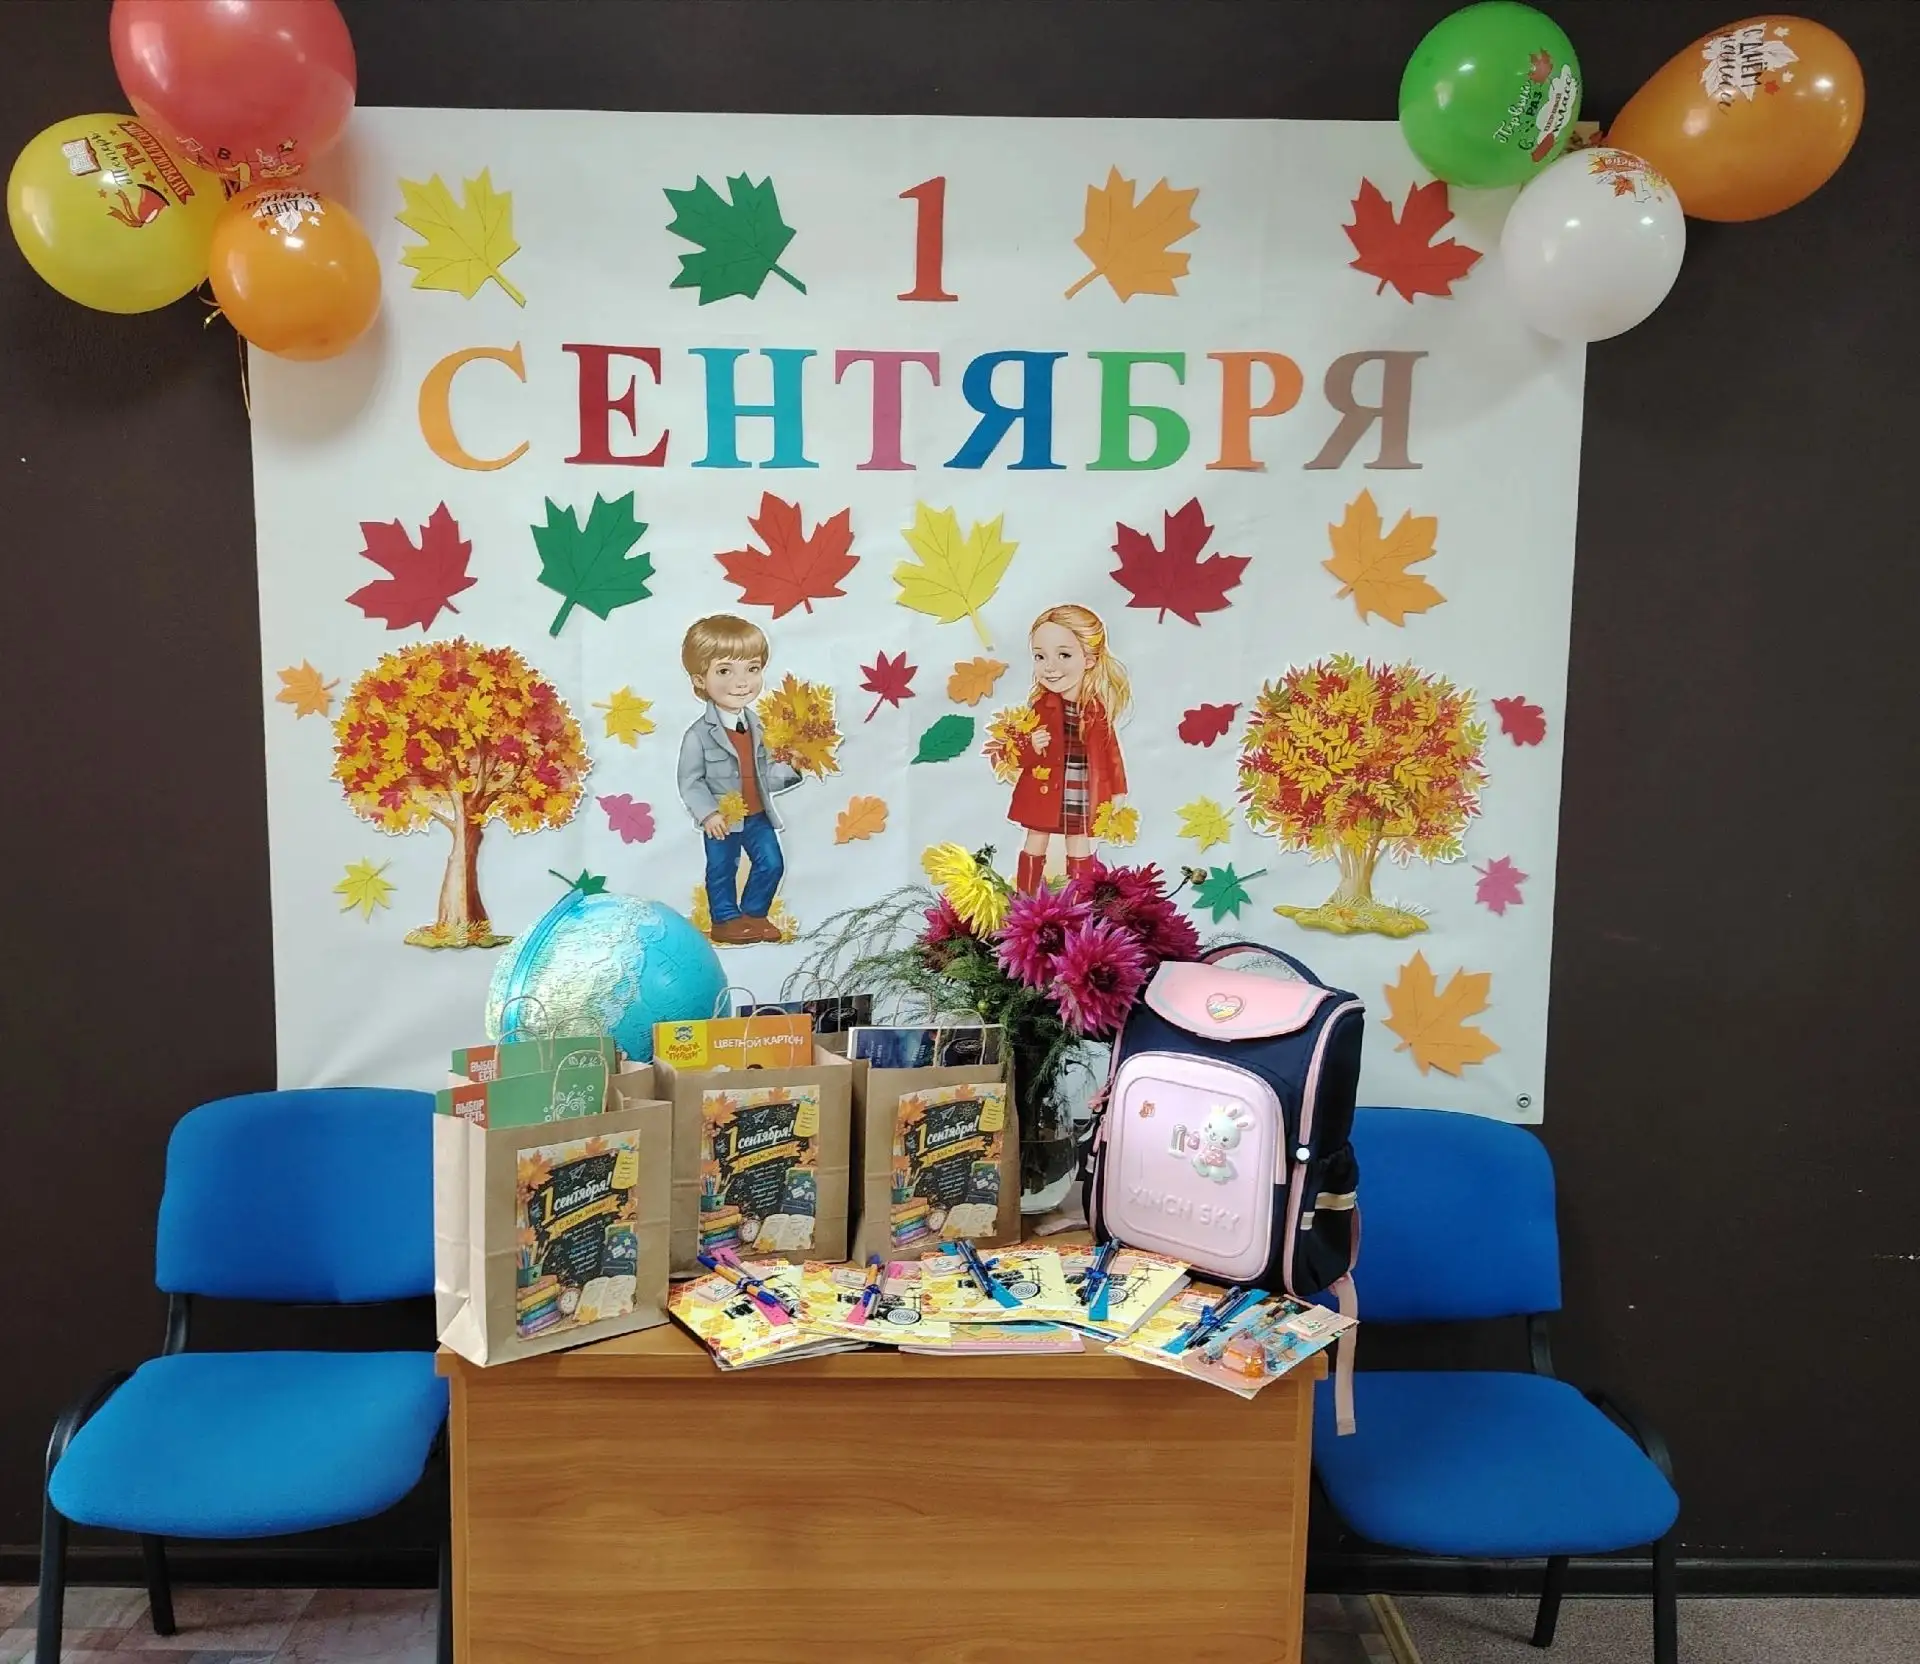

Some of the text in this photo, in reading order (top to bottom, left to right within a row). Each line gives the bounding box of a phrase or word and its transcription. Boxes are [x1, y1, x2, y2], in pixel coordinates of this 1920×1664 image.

[1493, 81, 1531, 143] Первый
[115, 142, 146, 170] ТЫ
[897, 176, 958, 301] 1
[418, 341, 1429, 471] СЕНТЯБРЯ
[714, 1034, 804, 1050] ЦВЕТНОЙ КАРТОН
[455, 1099, 484, 1115] ВЫБОР
[724, 1120, 795, 1161] 1 сентября!
[915, 1123, 929, 1157] 1
[927, 1114, 980, 1145] сентября!
[540, 1171, 613, 1226] 1 сентября!
[1200, 1203, 1240, 1232] SKY
